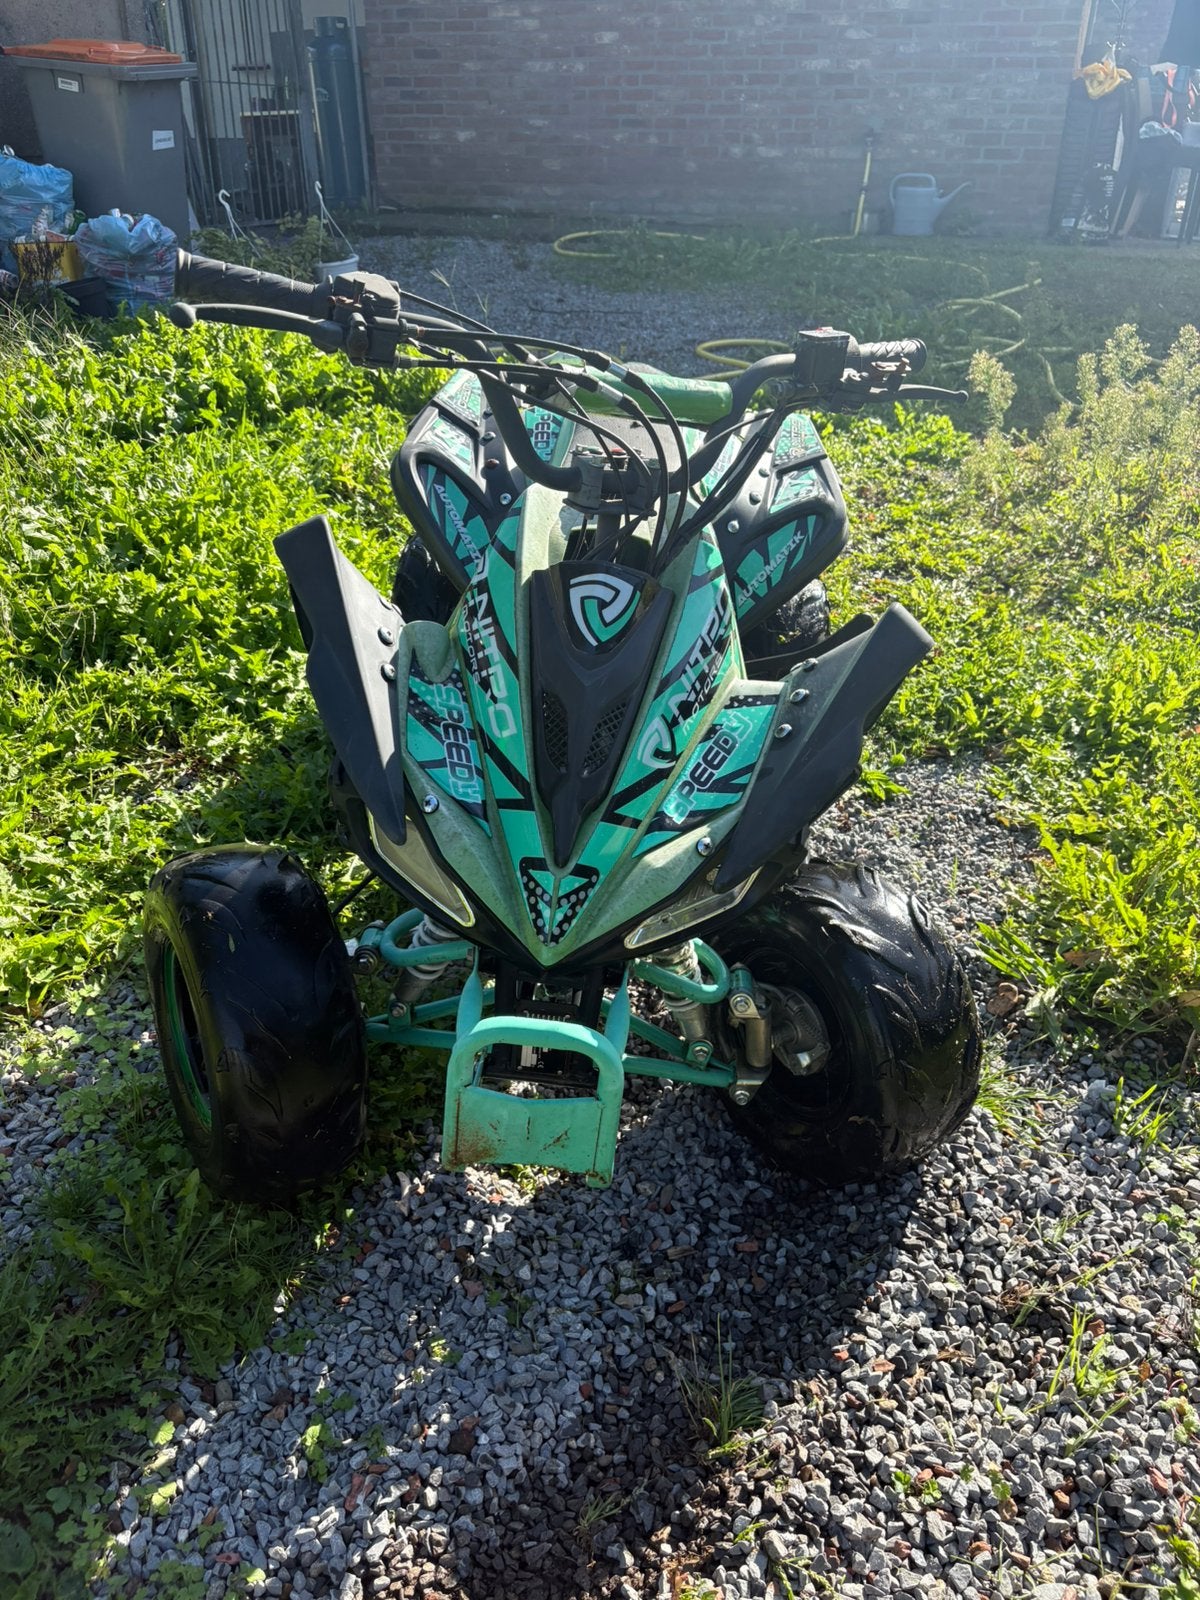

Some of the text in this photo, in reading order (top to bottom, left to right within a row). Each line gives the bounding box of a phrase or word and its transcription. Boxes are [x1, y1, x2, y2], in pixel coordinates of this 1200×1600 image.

[737, 530, 806, 608] AUTOMATIK
[462, 605, 482, 685] MOTORS
[468, 592, 518, 739] NITRO
[683, 652, 723, 736] MOTORS
[433, 683, 482, 804] SPEEDY
[663, 711, 753, 825] SPEEDY
